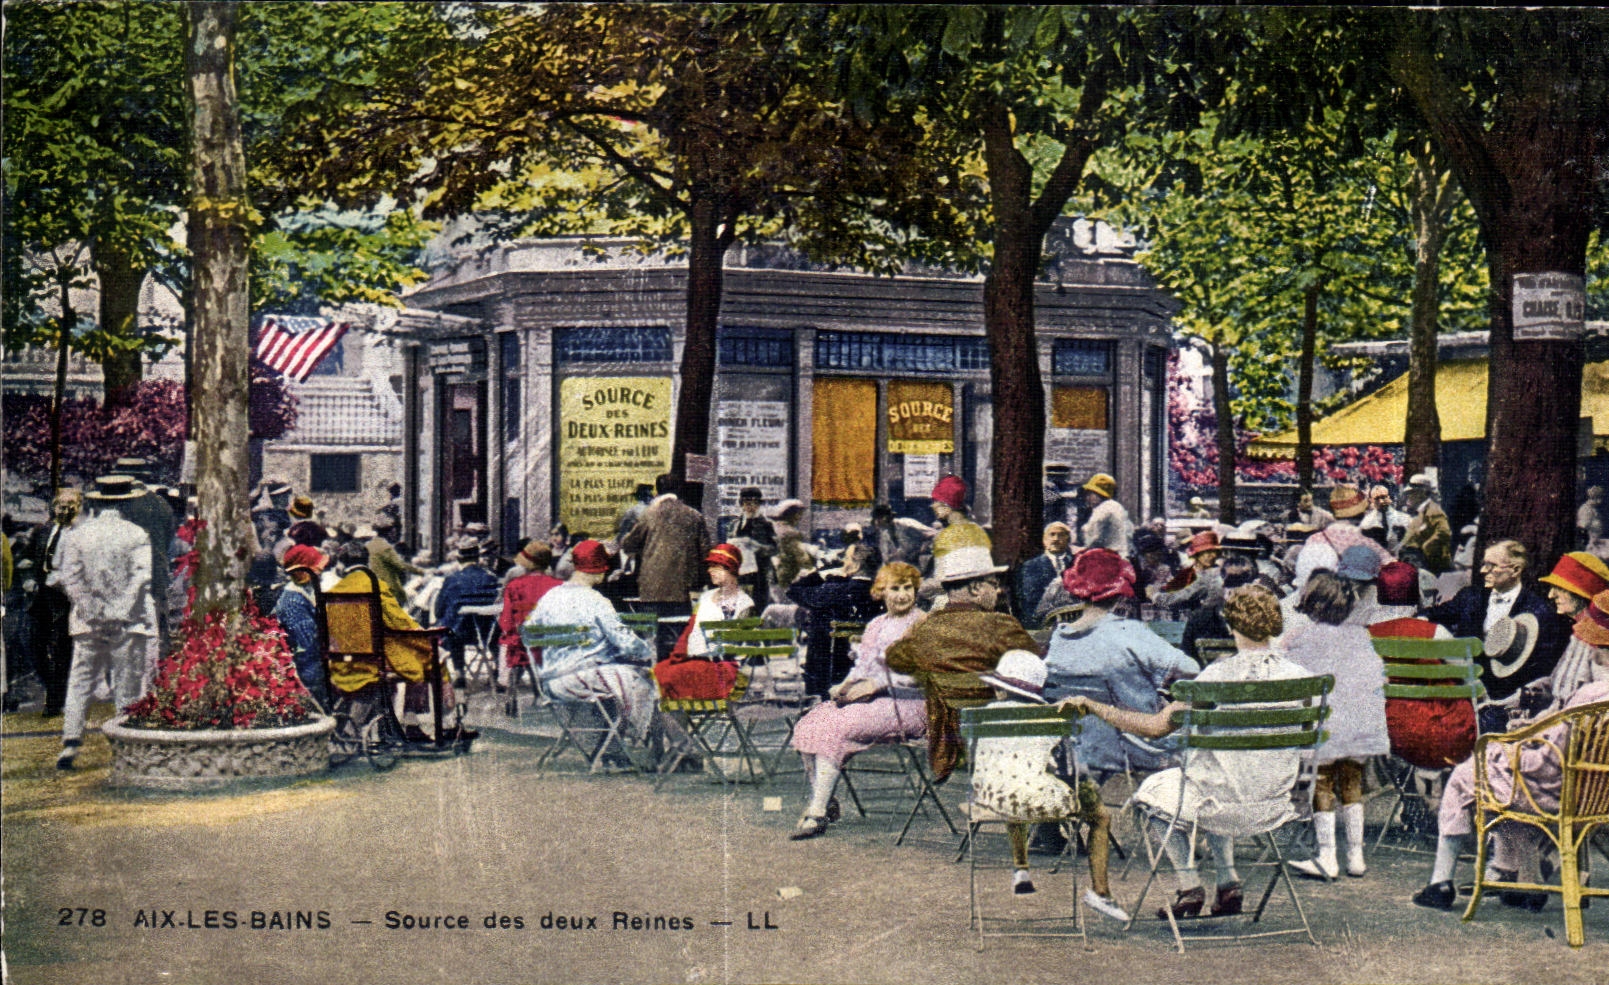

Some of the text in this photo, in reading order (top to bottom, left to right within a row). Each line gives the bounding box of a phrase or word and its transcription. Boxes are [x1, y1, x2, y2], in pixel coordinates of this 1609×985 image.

[582, 387, 655, 410] SOURCE
[606, 410, 629, 418] DES
[889, 401, 953, 423] SOURCE
